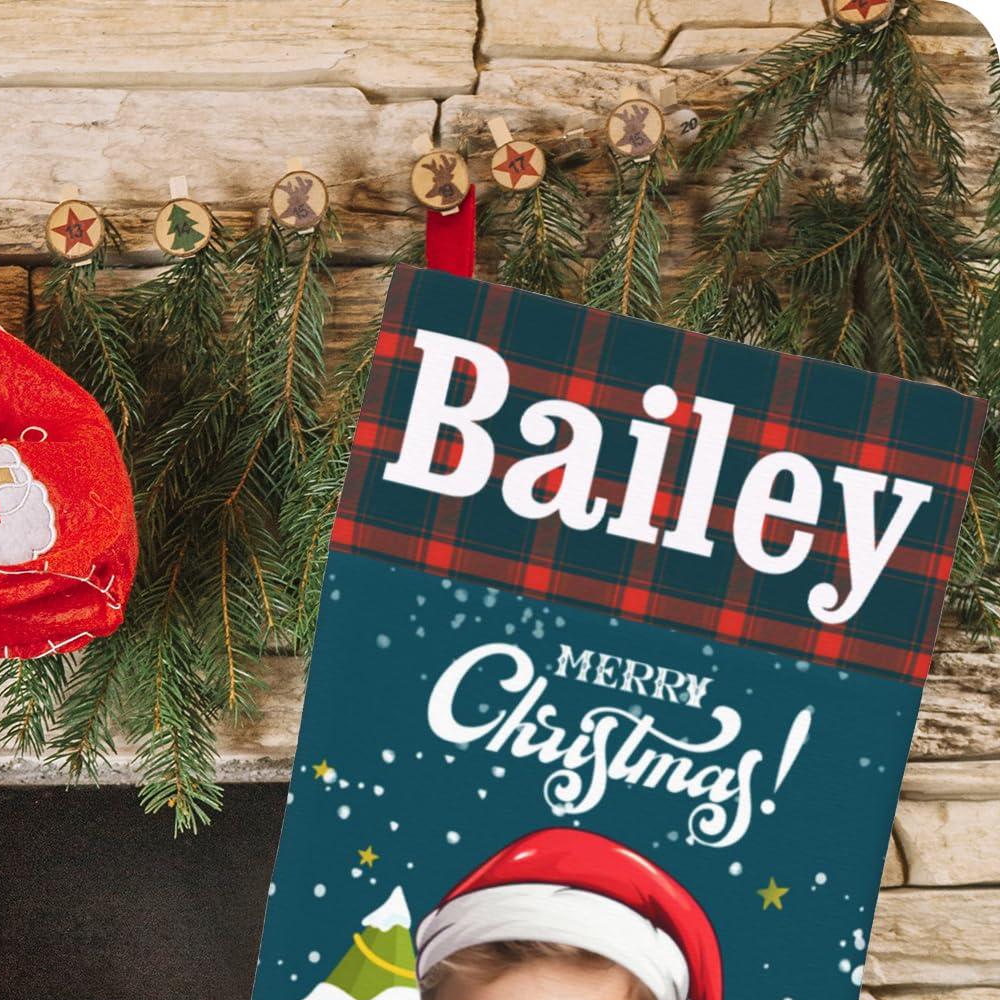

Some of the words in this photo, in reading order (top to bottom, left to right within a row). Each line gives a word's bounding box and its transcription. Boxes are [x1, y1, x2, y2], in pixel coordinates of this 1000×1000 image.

[679, 117, 699, 135] 20
[508, 155, 525, 173] 17
[66, 223, 83, 239] 13
[382, 329, 933, 625] Bailey
[554, 643, 713, 708] MERRY
